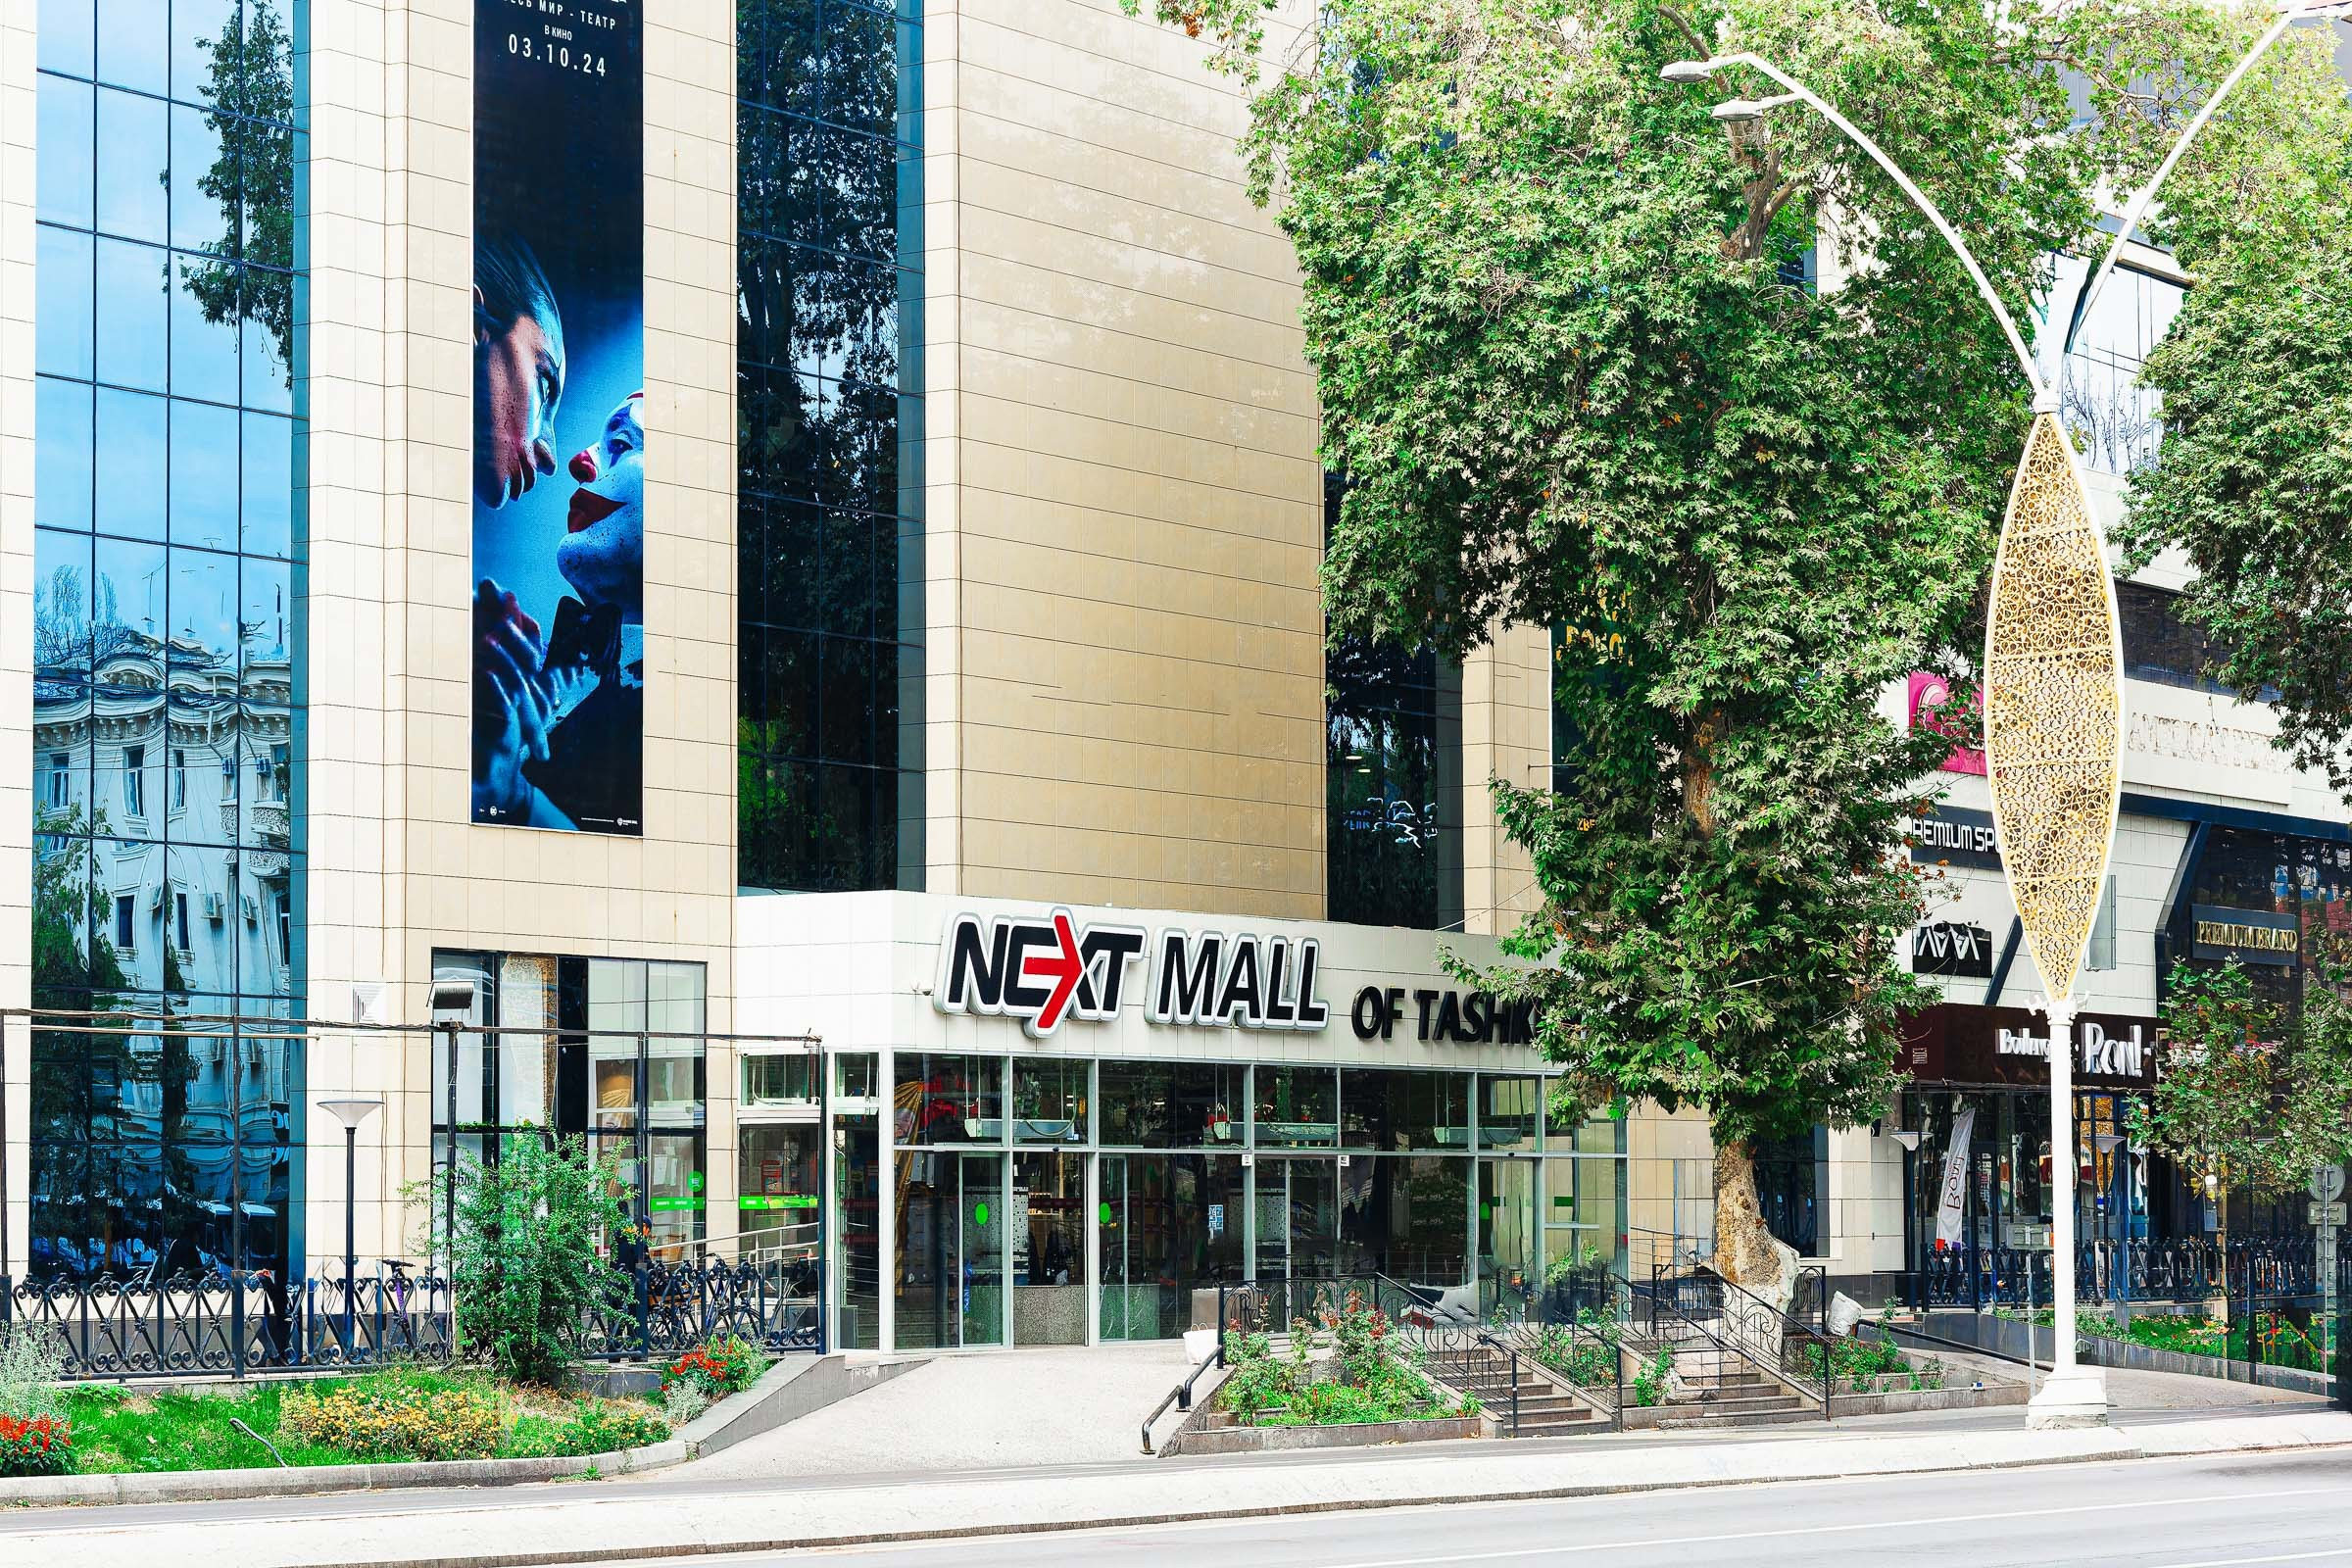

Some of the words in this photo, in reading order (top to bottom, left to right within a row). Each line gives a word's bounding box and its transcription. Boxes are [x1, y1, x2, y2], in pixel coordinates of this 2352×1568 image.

[539, 1, 564, 16] МИР
[580, 10, 616, 30] ТЕАТР
[544, 24, 550, 35] В
[552, 26, 572, 41] КИНО
[509, 33, 606, 76] 03.10.24
[1908, 819, 1973, 851] REMIUM
[2196, 920, 2255, 948] PREMIUM
[2256, 926, 2298, 952] BRAND
[943, 912, 1147, 1031] NEXT
[1156, 935, 1327, 1023] MALL
[1351, 985, 1405, 1040] OF
[1413, 989, 1545, 1045] TASHK
